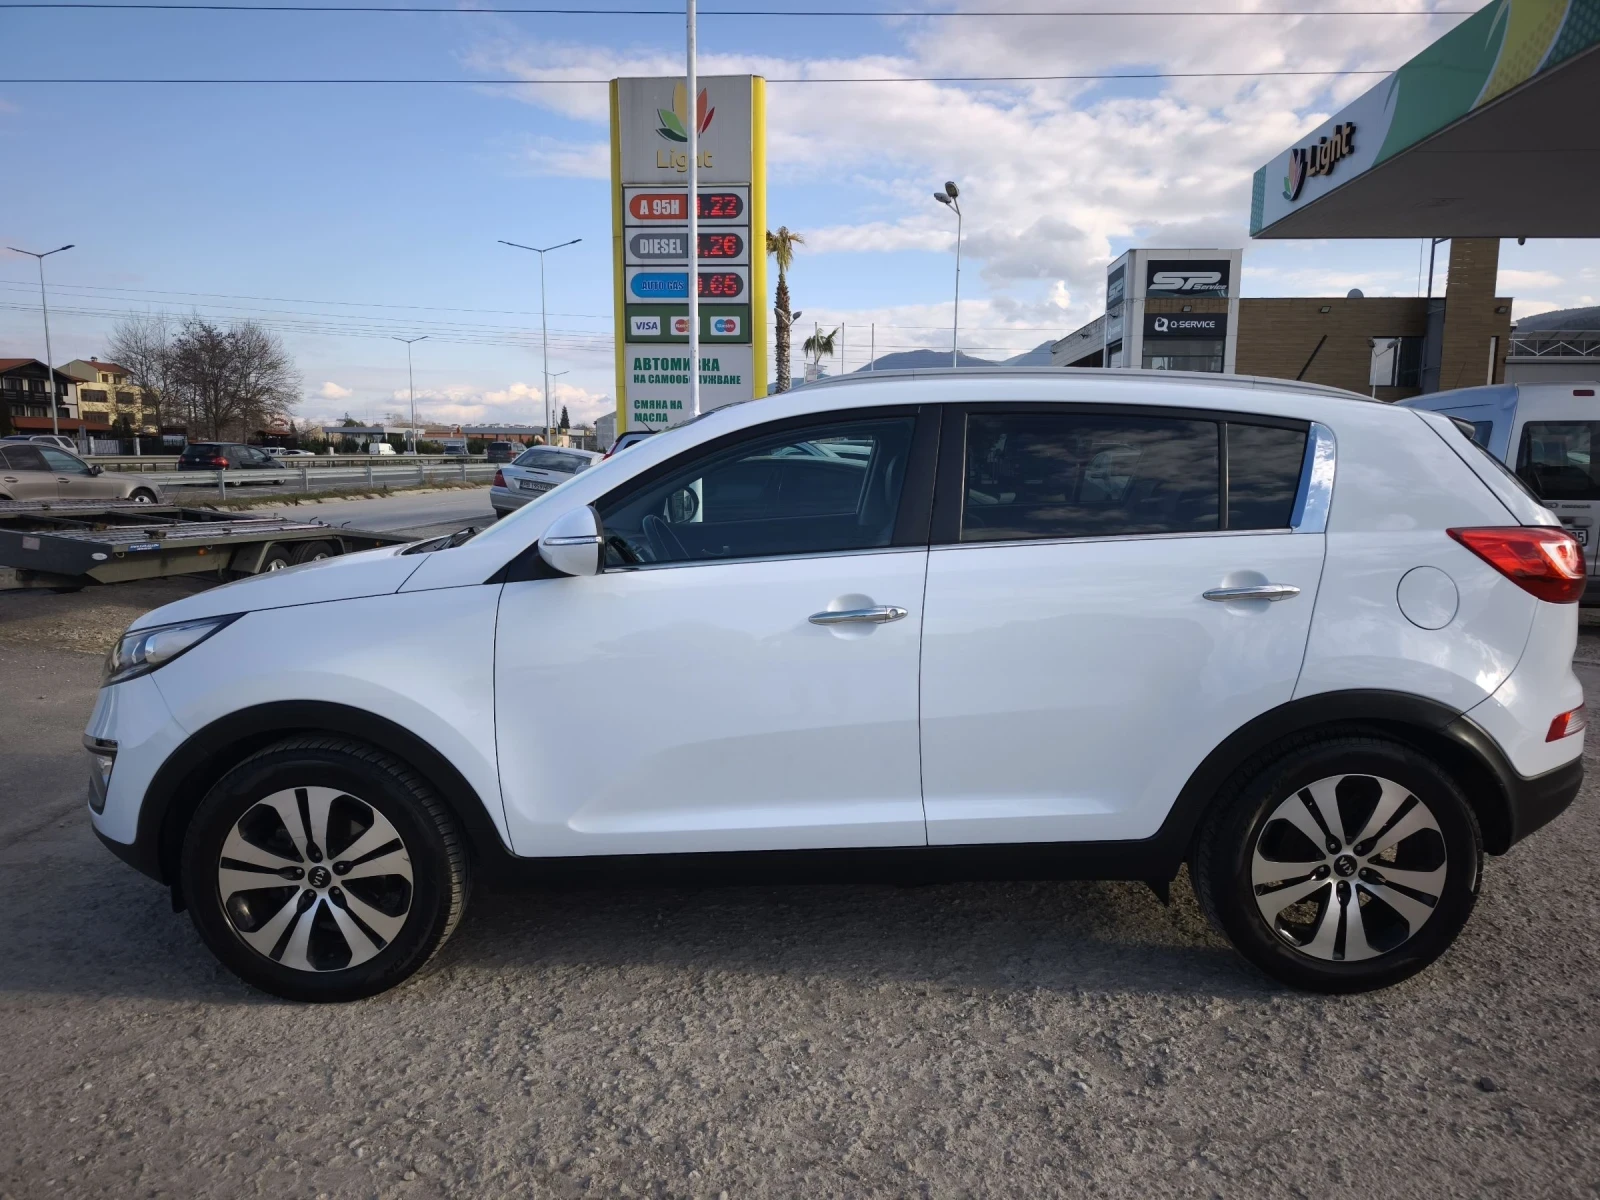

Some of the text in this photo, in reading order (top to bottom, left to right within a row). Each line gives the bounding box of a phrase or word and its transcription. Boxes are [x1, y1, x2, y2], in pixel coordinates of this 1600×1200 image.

[1305, 121, 1356, 177] Light
[639, 238, 683, 254] DIESEL
[697, 236, 737, 256] .26
[641, 280, 685, 291] AUTO GAS
[1148, 271, 1222, 290] SP
[635, 321, 659, 331] VISA
[633, 374, 647, 384] НА
[633, 399, 683, 410] СМЯНА НА
[633, 412, 669, 423] МАСЛА
